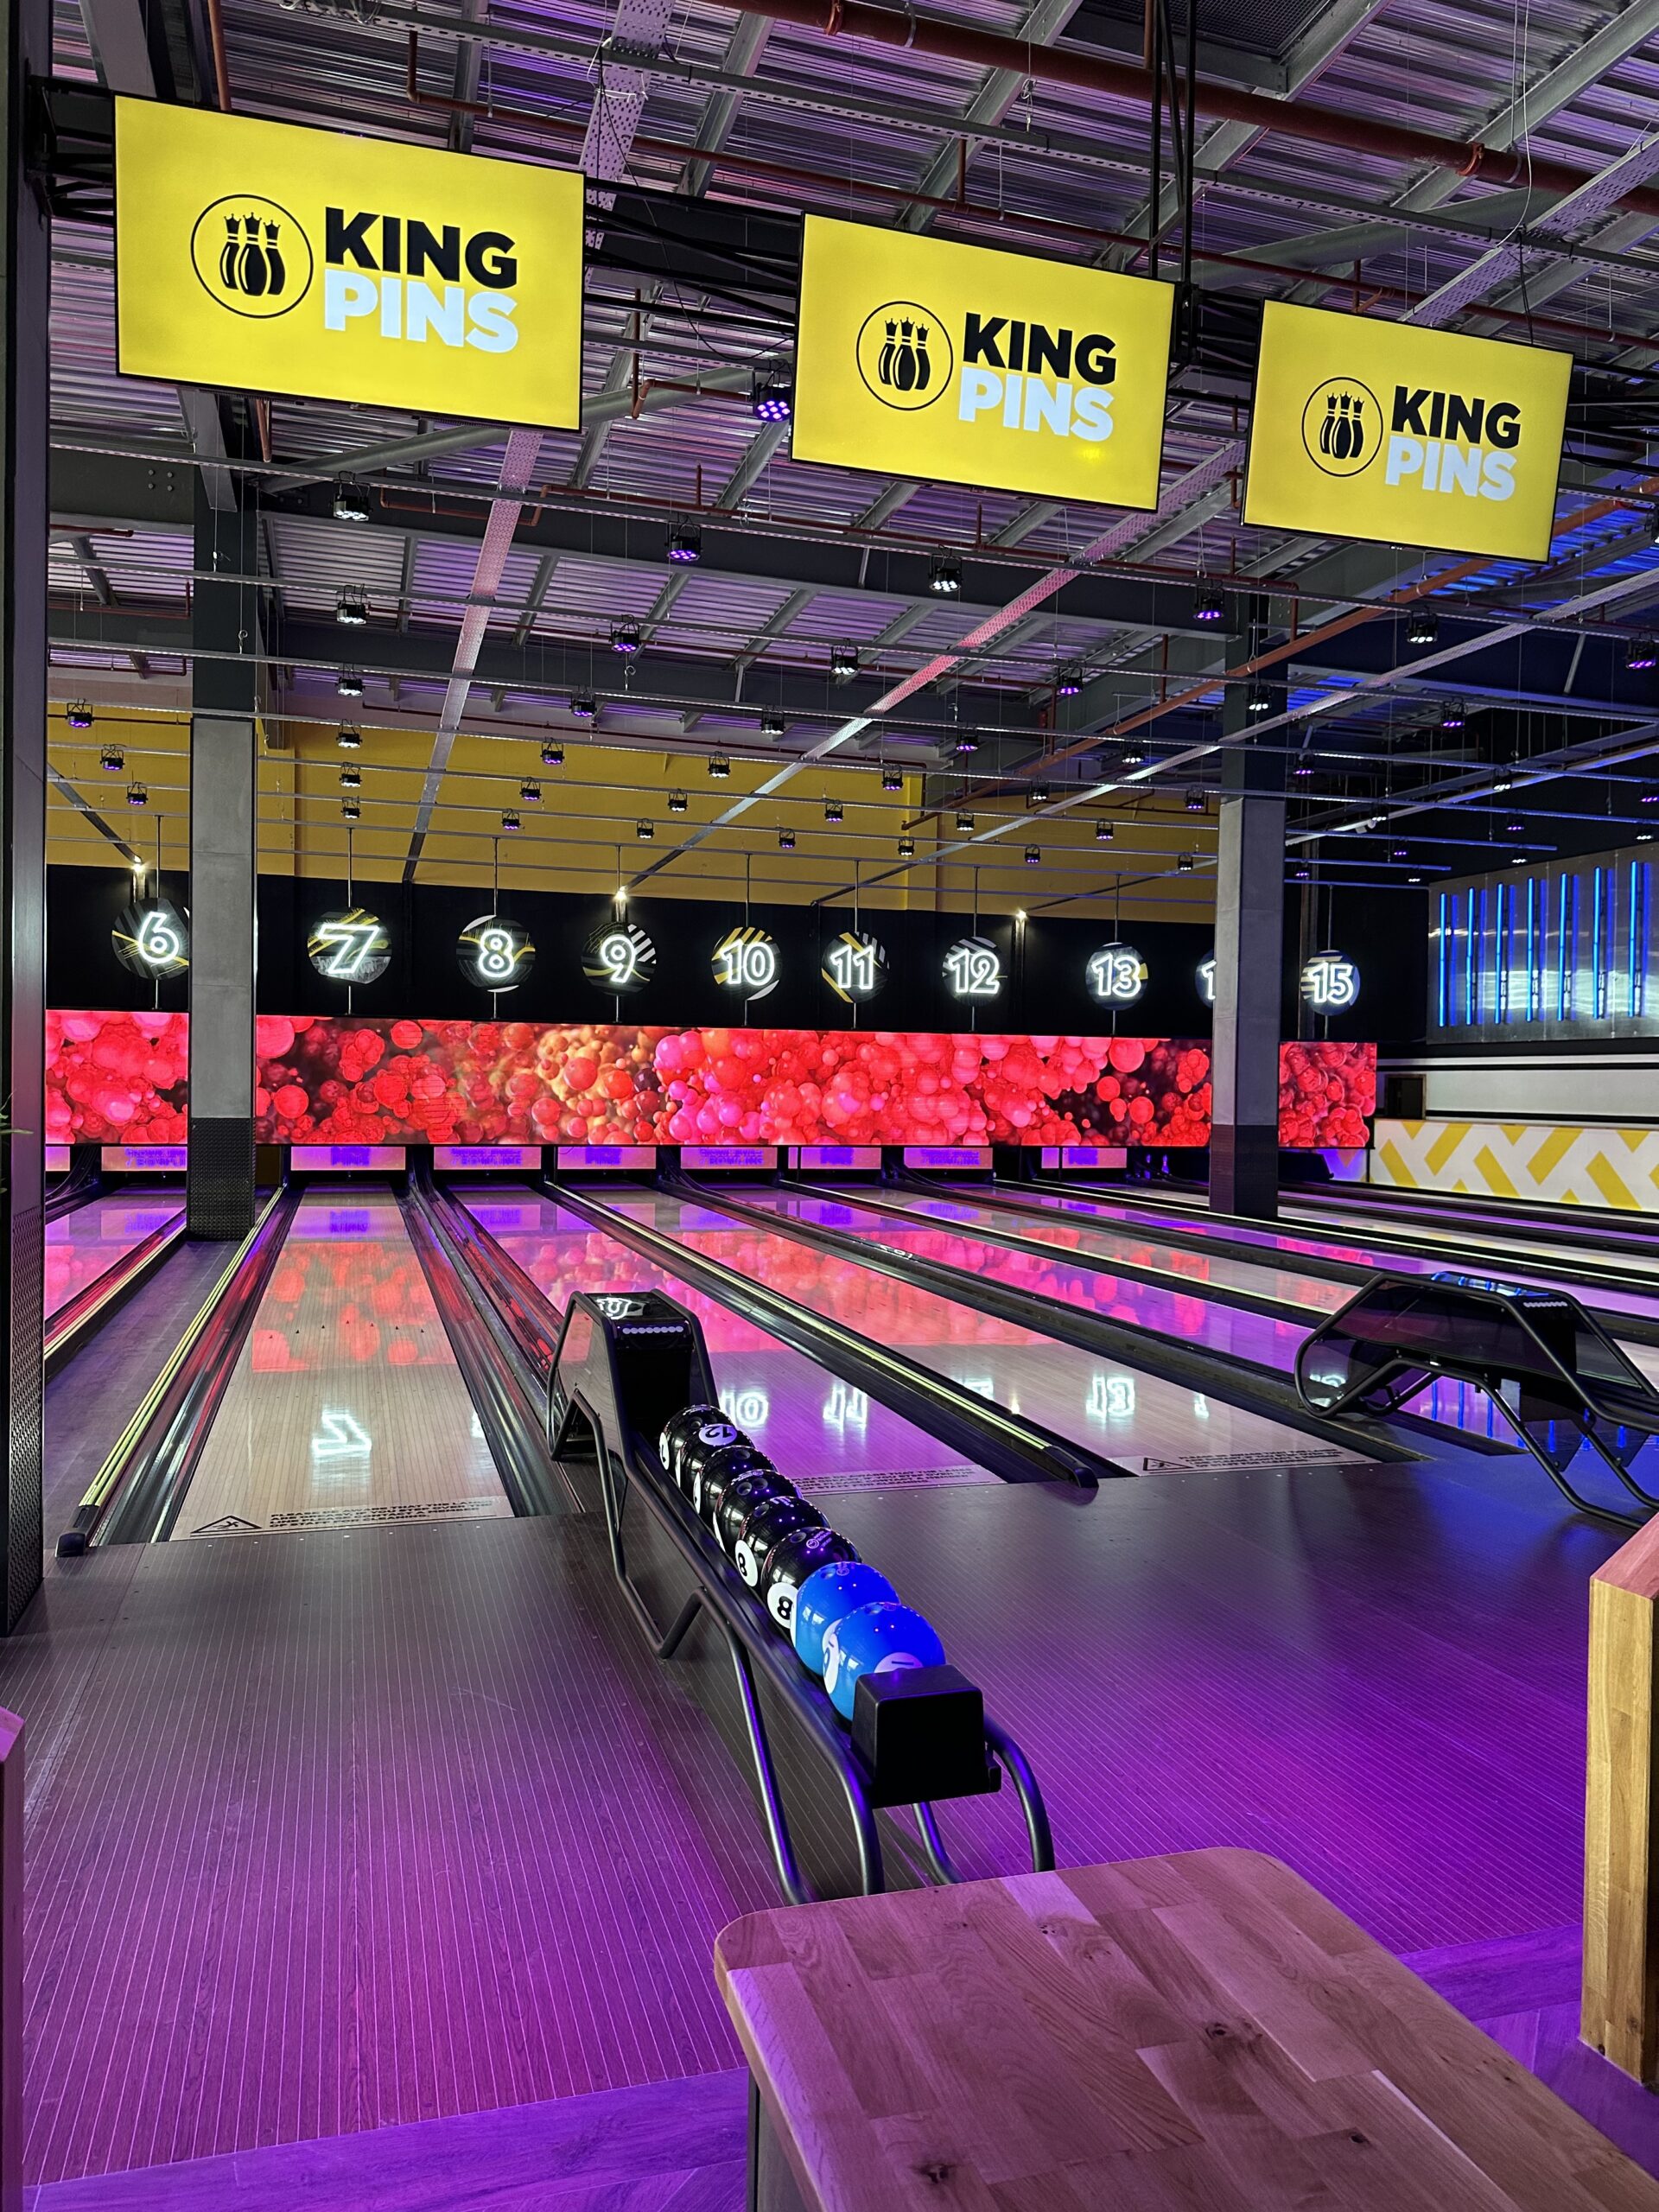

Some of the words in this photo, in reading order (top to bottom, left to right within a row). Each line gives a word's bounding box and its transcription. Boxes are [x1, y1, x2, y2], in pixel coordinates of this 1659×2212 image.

[325, 207, 518, 289] KING
[324, 268, 518, 353] PINS
[963, 312, 1116, 385] KING
[959, 366, 1115, 443] PINS
[1391, 385, 1521, 449] KING
[1385, 435, 1516, 501] PINS
[137, 911, 181, 965] 6
[316, 923, 380, 975] 7
[478, 929, 516, 978] 8
[601, 933, 636, 984] 9
[718, 939, 775, 986] 10
[829, 945, 874, 990] 11
[947, 949, 1001, 995] 12
[1091, 953, 1141, 997] 13
[1306, 960, 1354, 1004] 15
[704, 1426, 734, 1439] 12
[739, 1552, 747, 1577] 8
[777, 1595, 794, 1620] 8
